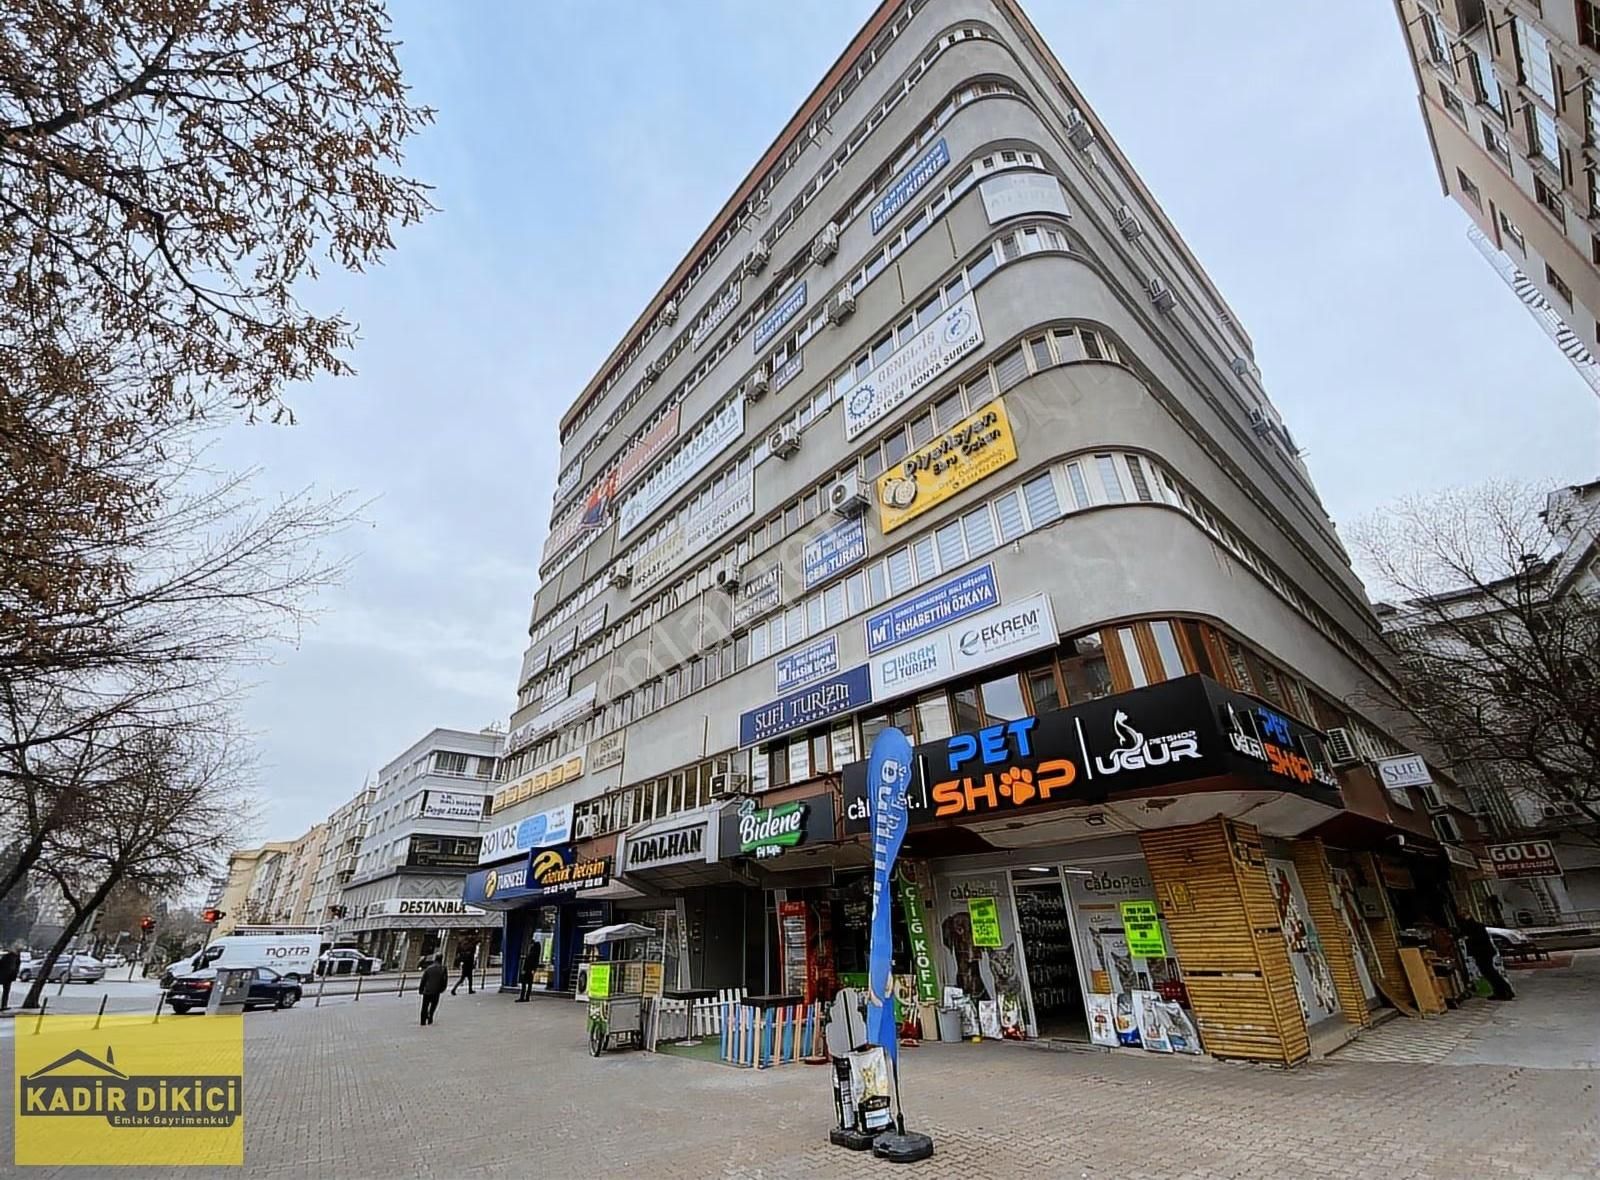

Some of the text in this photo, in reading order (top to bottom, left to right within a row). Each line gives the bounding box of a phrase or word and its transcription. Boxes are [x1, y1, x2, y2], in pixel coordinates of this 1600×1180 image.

[910, 362, 942, 390] KONYA
[951, 584, 993, 612] ÖZKAYA
[981, 609, 1038, 642] EKREM
[948, 716, 1037, 772] PET
[739, 807, 801, 845] Bidene
[629, 827, 703, 865] ADALHAN
[1490, 843, 1551, 862] GOLD
[914, 939, 936, 1001] KÖFT
